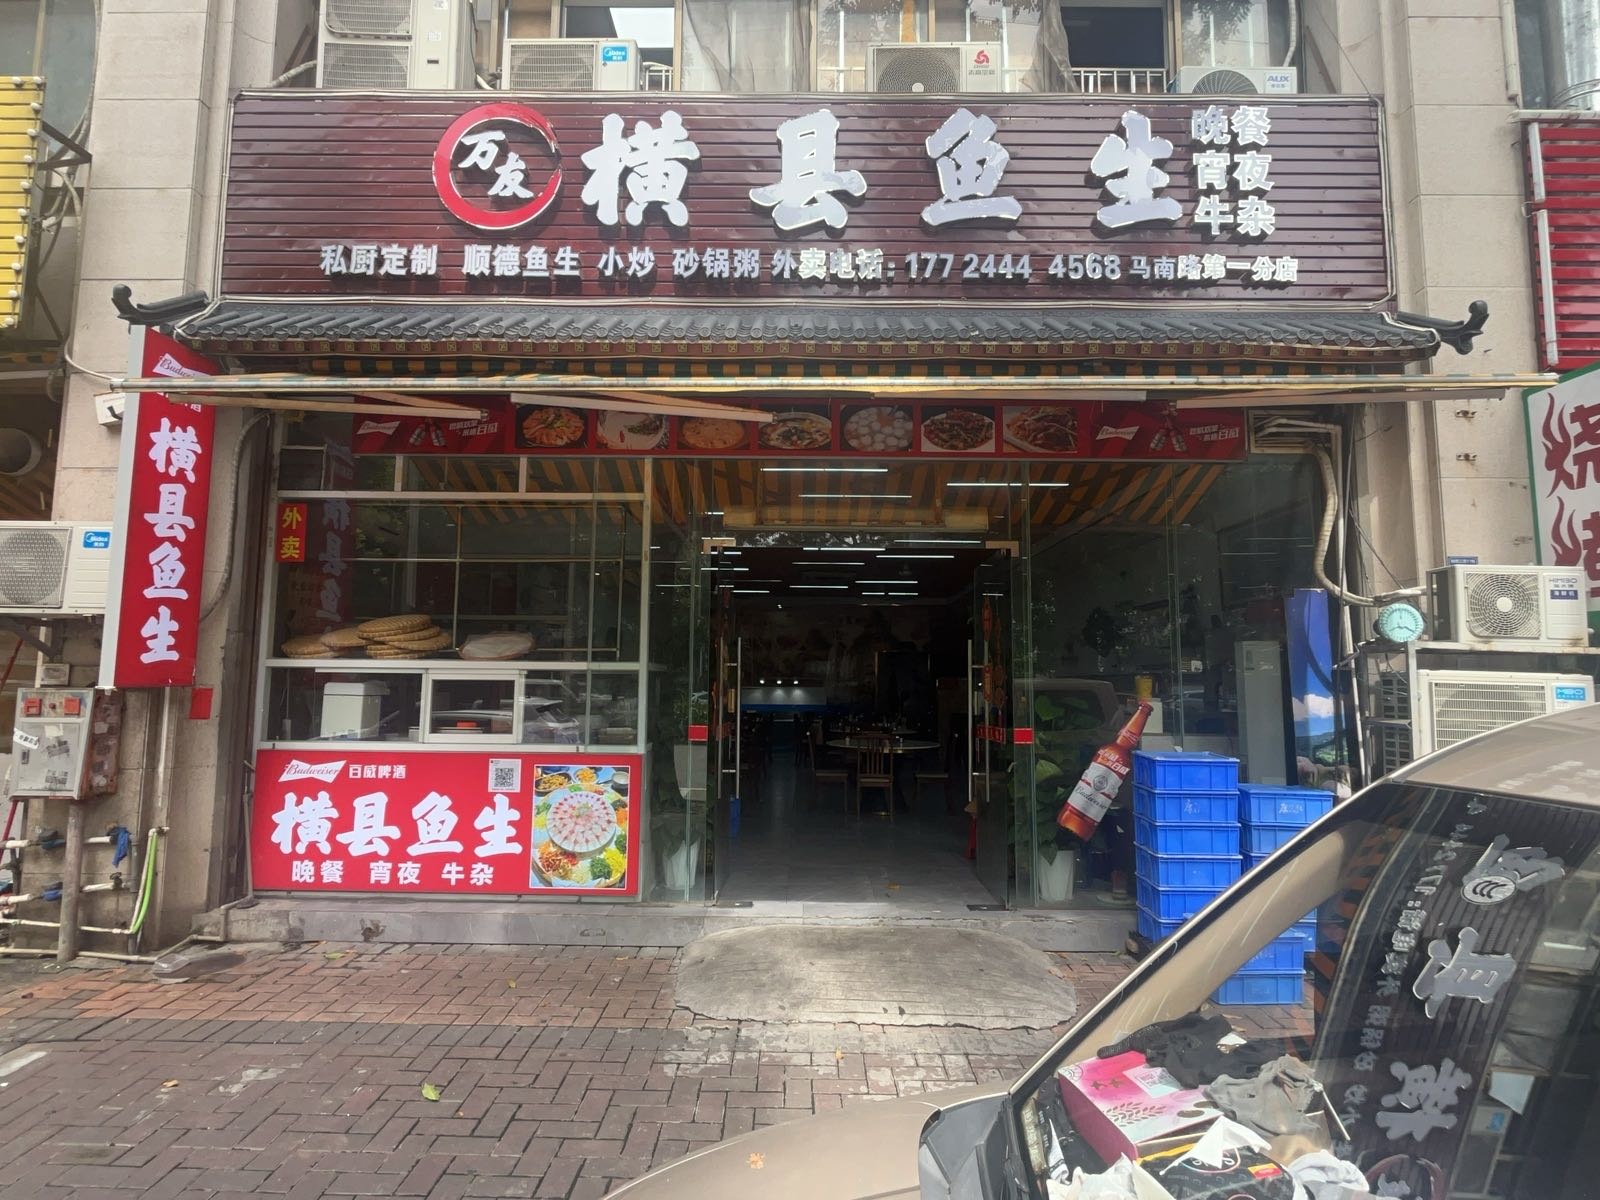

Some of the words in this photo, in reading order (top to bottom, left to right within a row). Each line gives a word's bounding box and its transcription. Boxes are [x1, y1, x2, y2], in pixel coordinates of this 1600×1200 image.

[1192, 105, 1271, 146] 晚餐
[581, 107, 1183, 231] 横县鱼生
[1193, 150, 1275, 191] 宵夜
[1195, 195, 1275, 236] 牛杂
[320, 243, 438, 276] 私厨定制
[462, 244, 581, 278] 顺德鱼生
[598, 246, 656, 278] 小炒
[672, 247, 760, 280] 砂锅粥
[904, 252, 954, 279] 177
[963, 253, 1032, 280] 2444
[1048, 253, 1122, 280] 4568
[139, 416, 203, 665] 横县鱼生
[281, 506, 302, 559] 外卖
[286, 761, 340, 778] Budweiser
[349, 764, 406, 779] 百威啤酒
[271, 791, 523, 858] 横县鱼生
[292, 859, 344, 884] 晚餐
[369, 861, 422, 886] 宵夜
[441, 862, 494, 886] 牛杂
